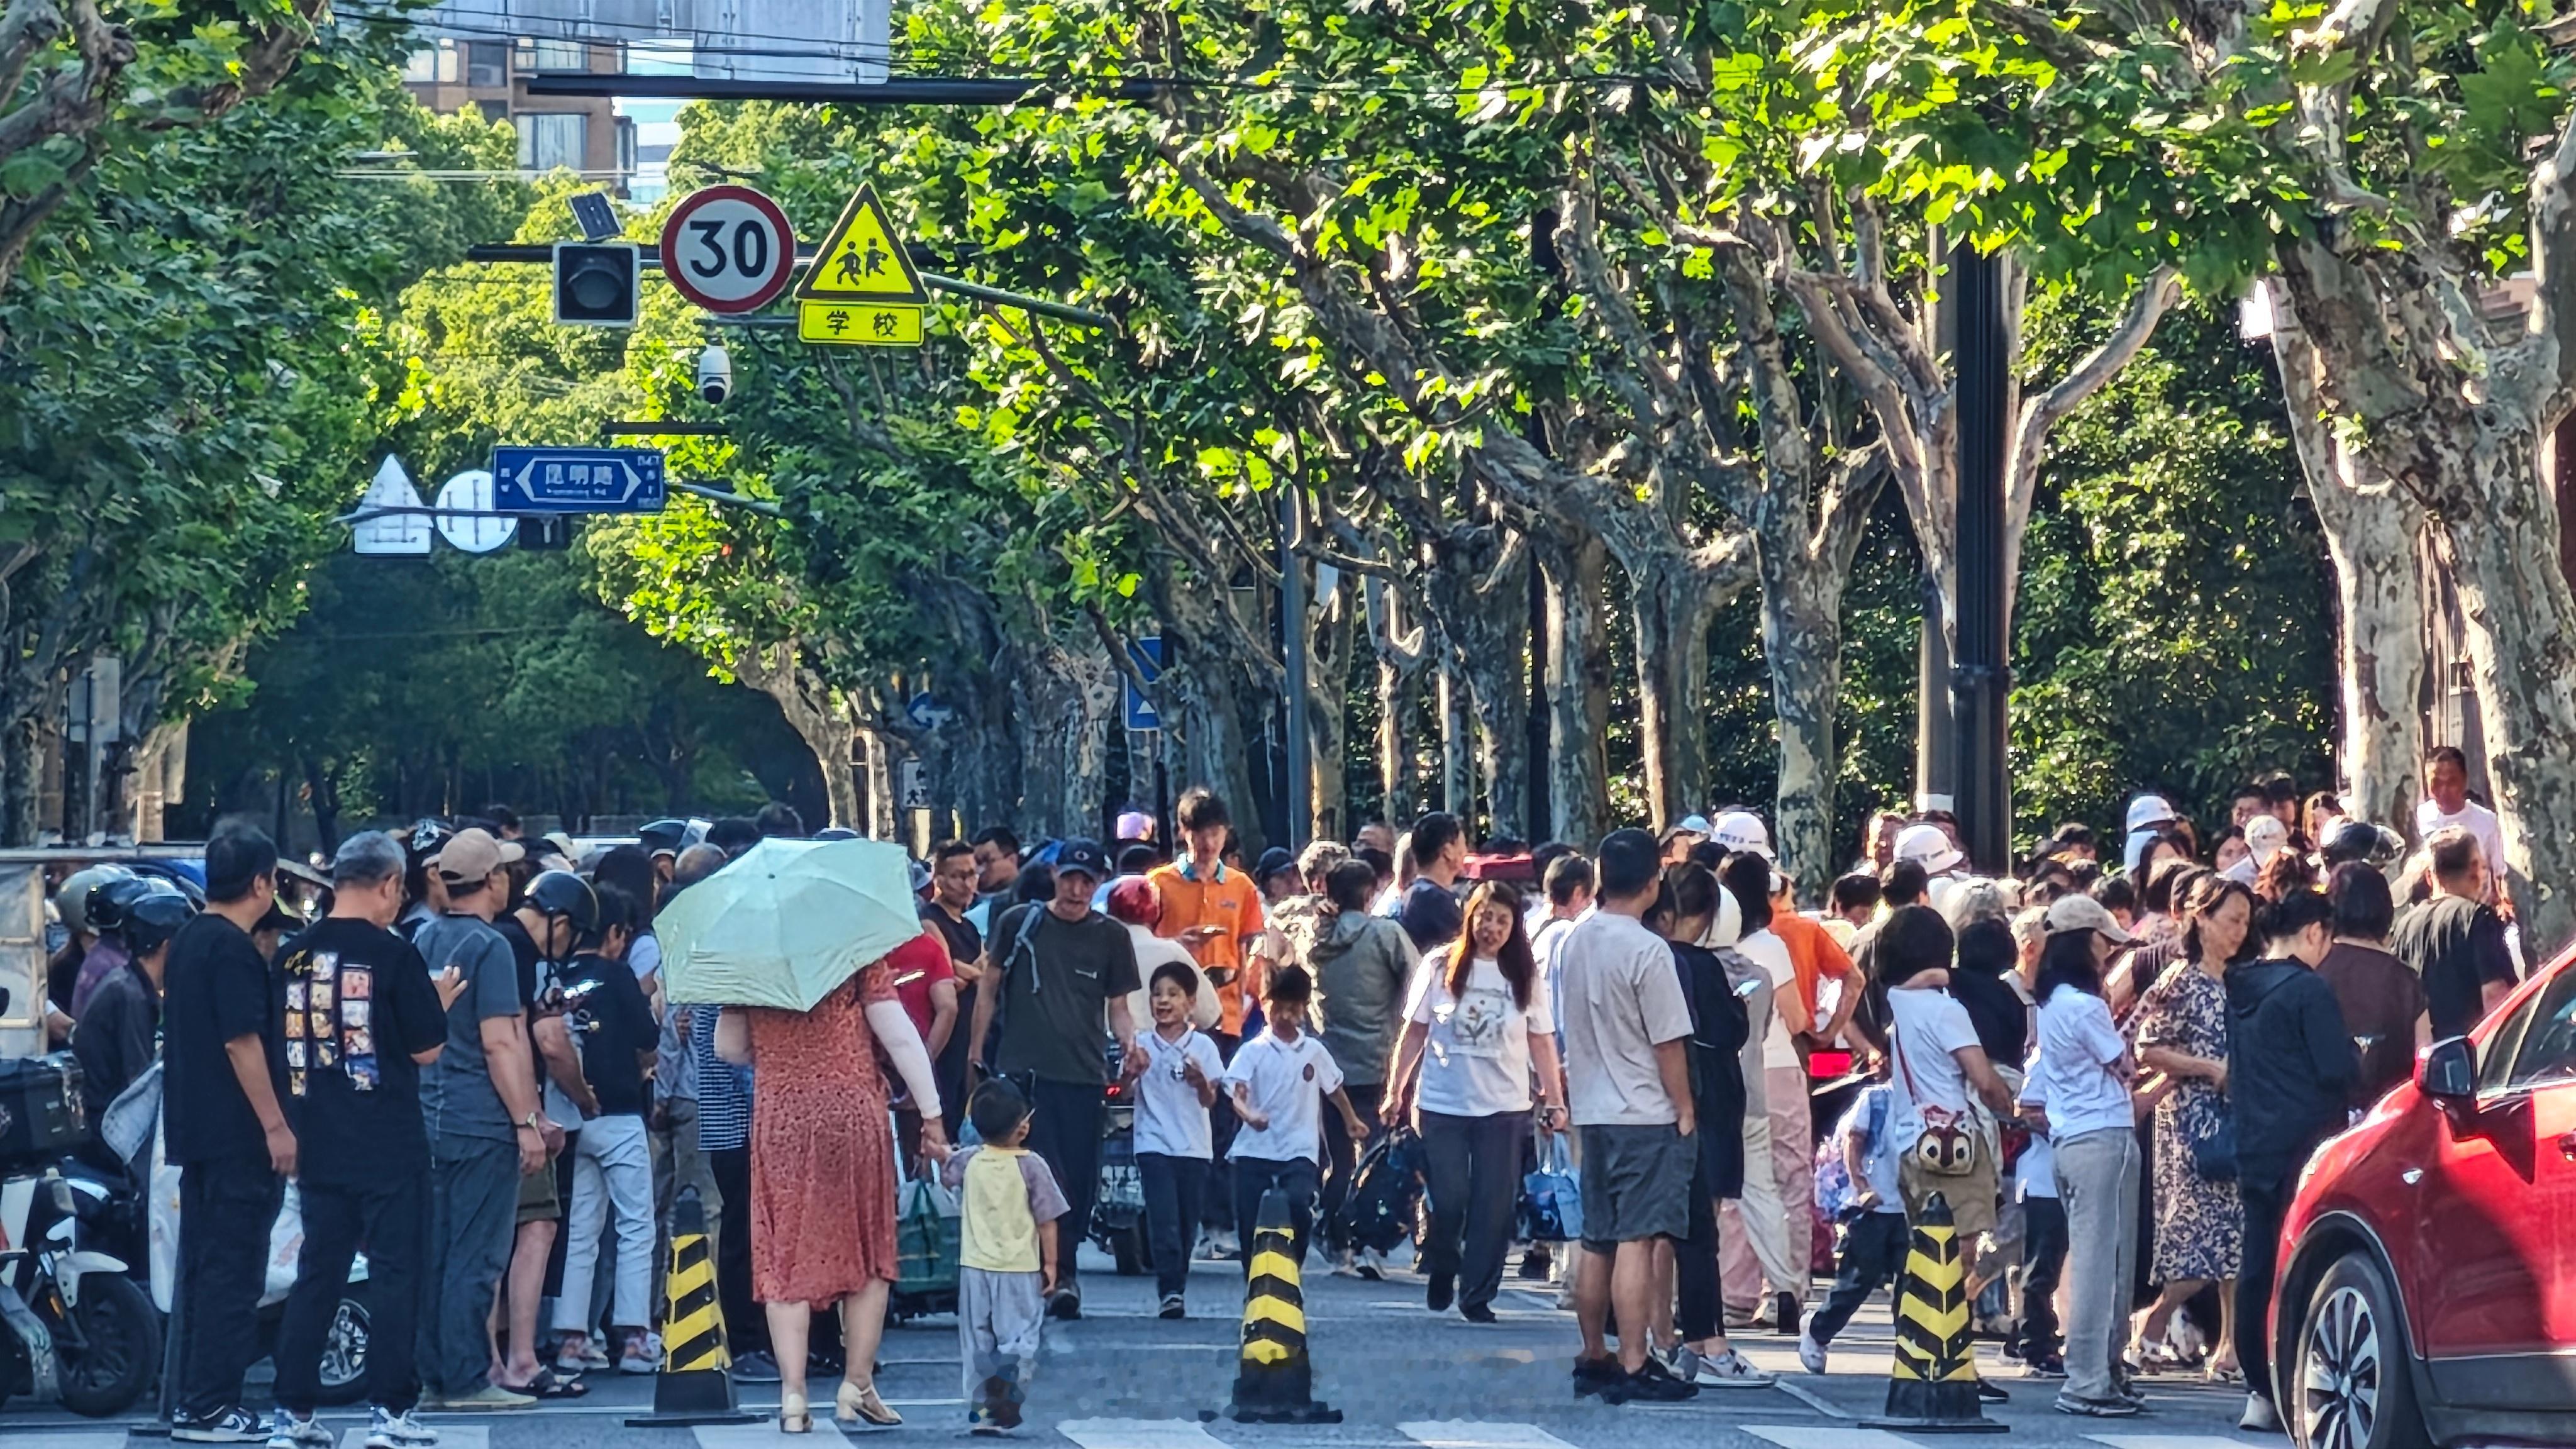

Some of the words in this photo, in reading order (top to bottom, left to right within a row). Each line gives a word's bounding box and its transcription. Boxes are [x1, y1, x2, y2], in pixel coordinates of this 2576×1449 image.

[689, 219, 767, 279] 30
[826, 309, 898, 338] 学校
[545, 464, 613, 486] 昆明路
